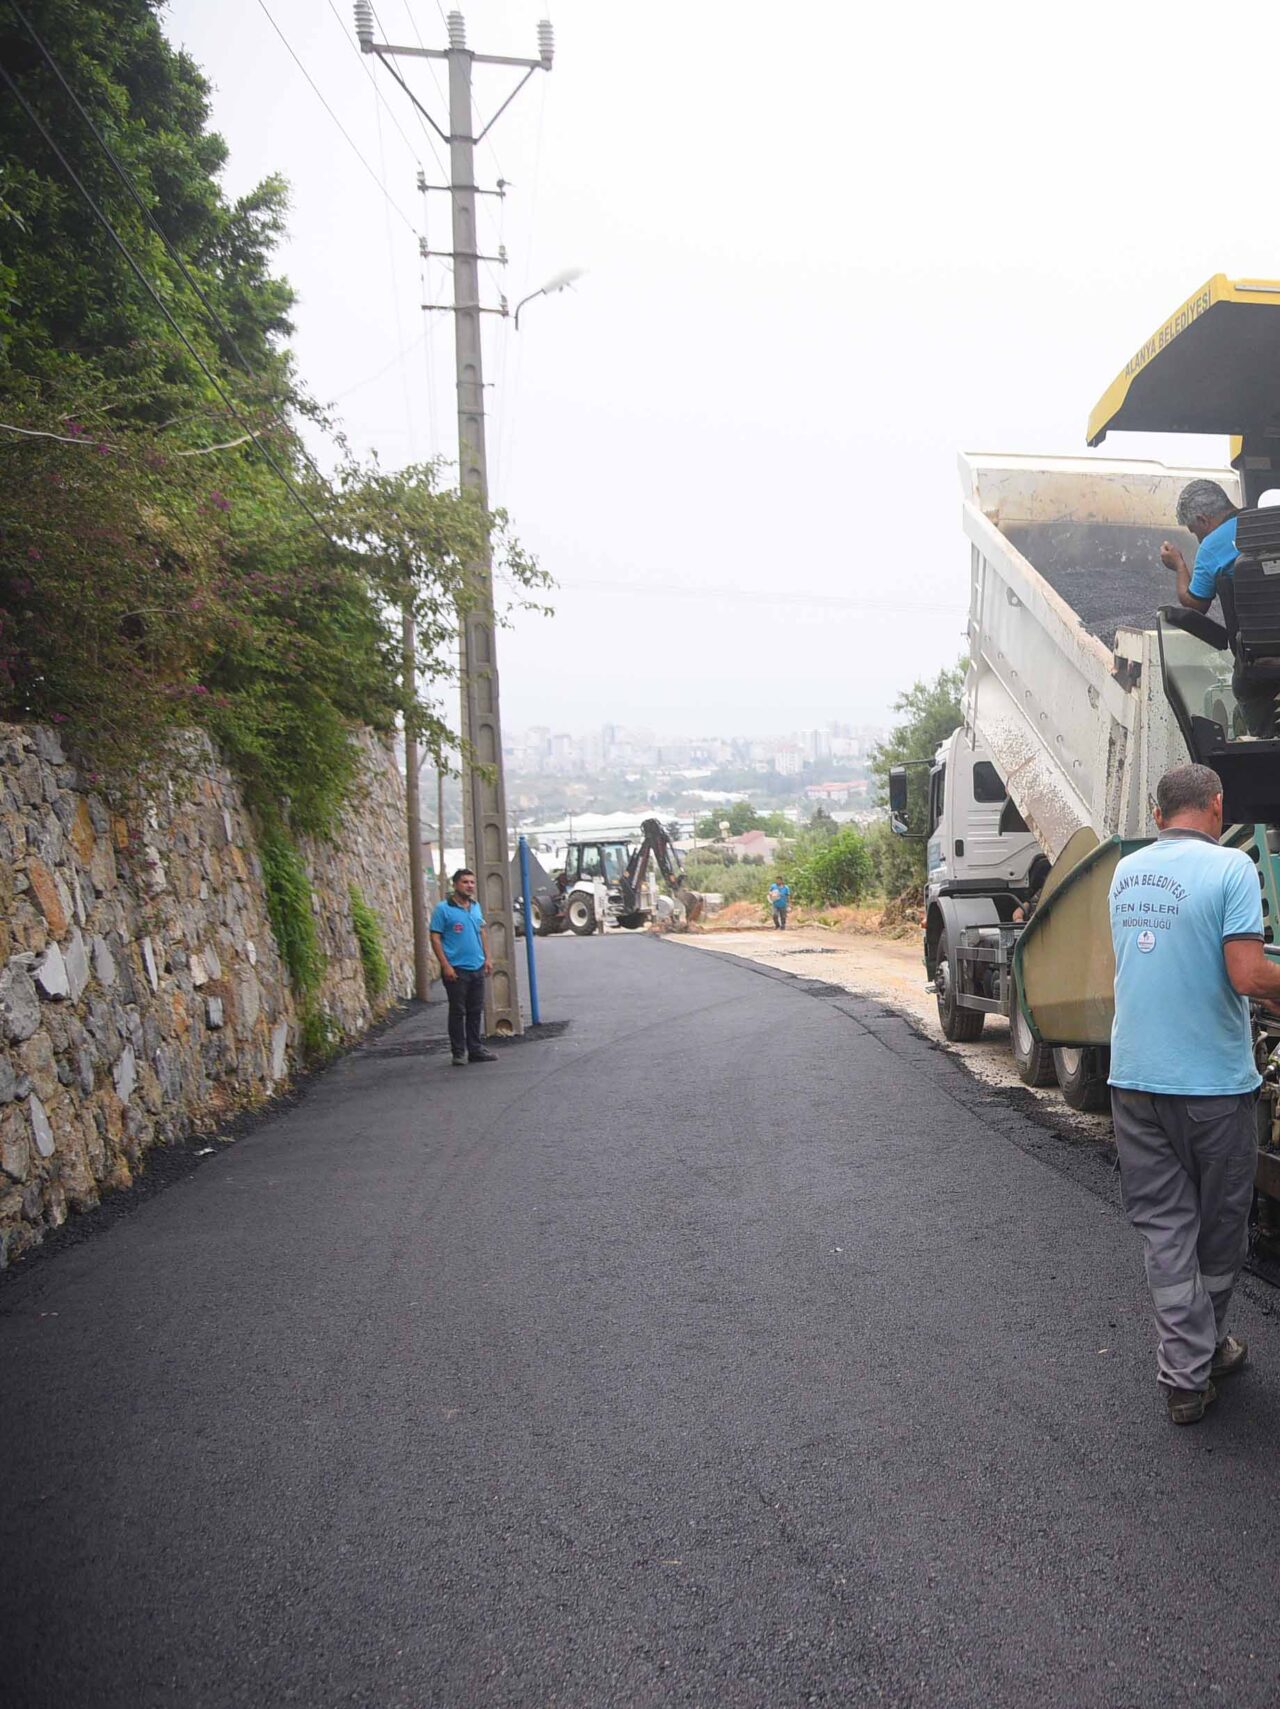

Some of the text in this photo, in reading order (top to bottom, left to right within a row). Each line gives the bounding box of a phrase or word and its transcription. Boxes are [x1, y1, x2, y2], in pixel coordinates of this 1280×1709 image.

[1125, 337, 1157, 379] ALANYA
[1113, 874, 1191, 902] ALANYA BELEDİYESİ
[1115, 900, 1179, 915] FEN İŞLERİ
